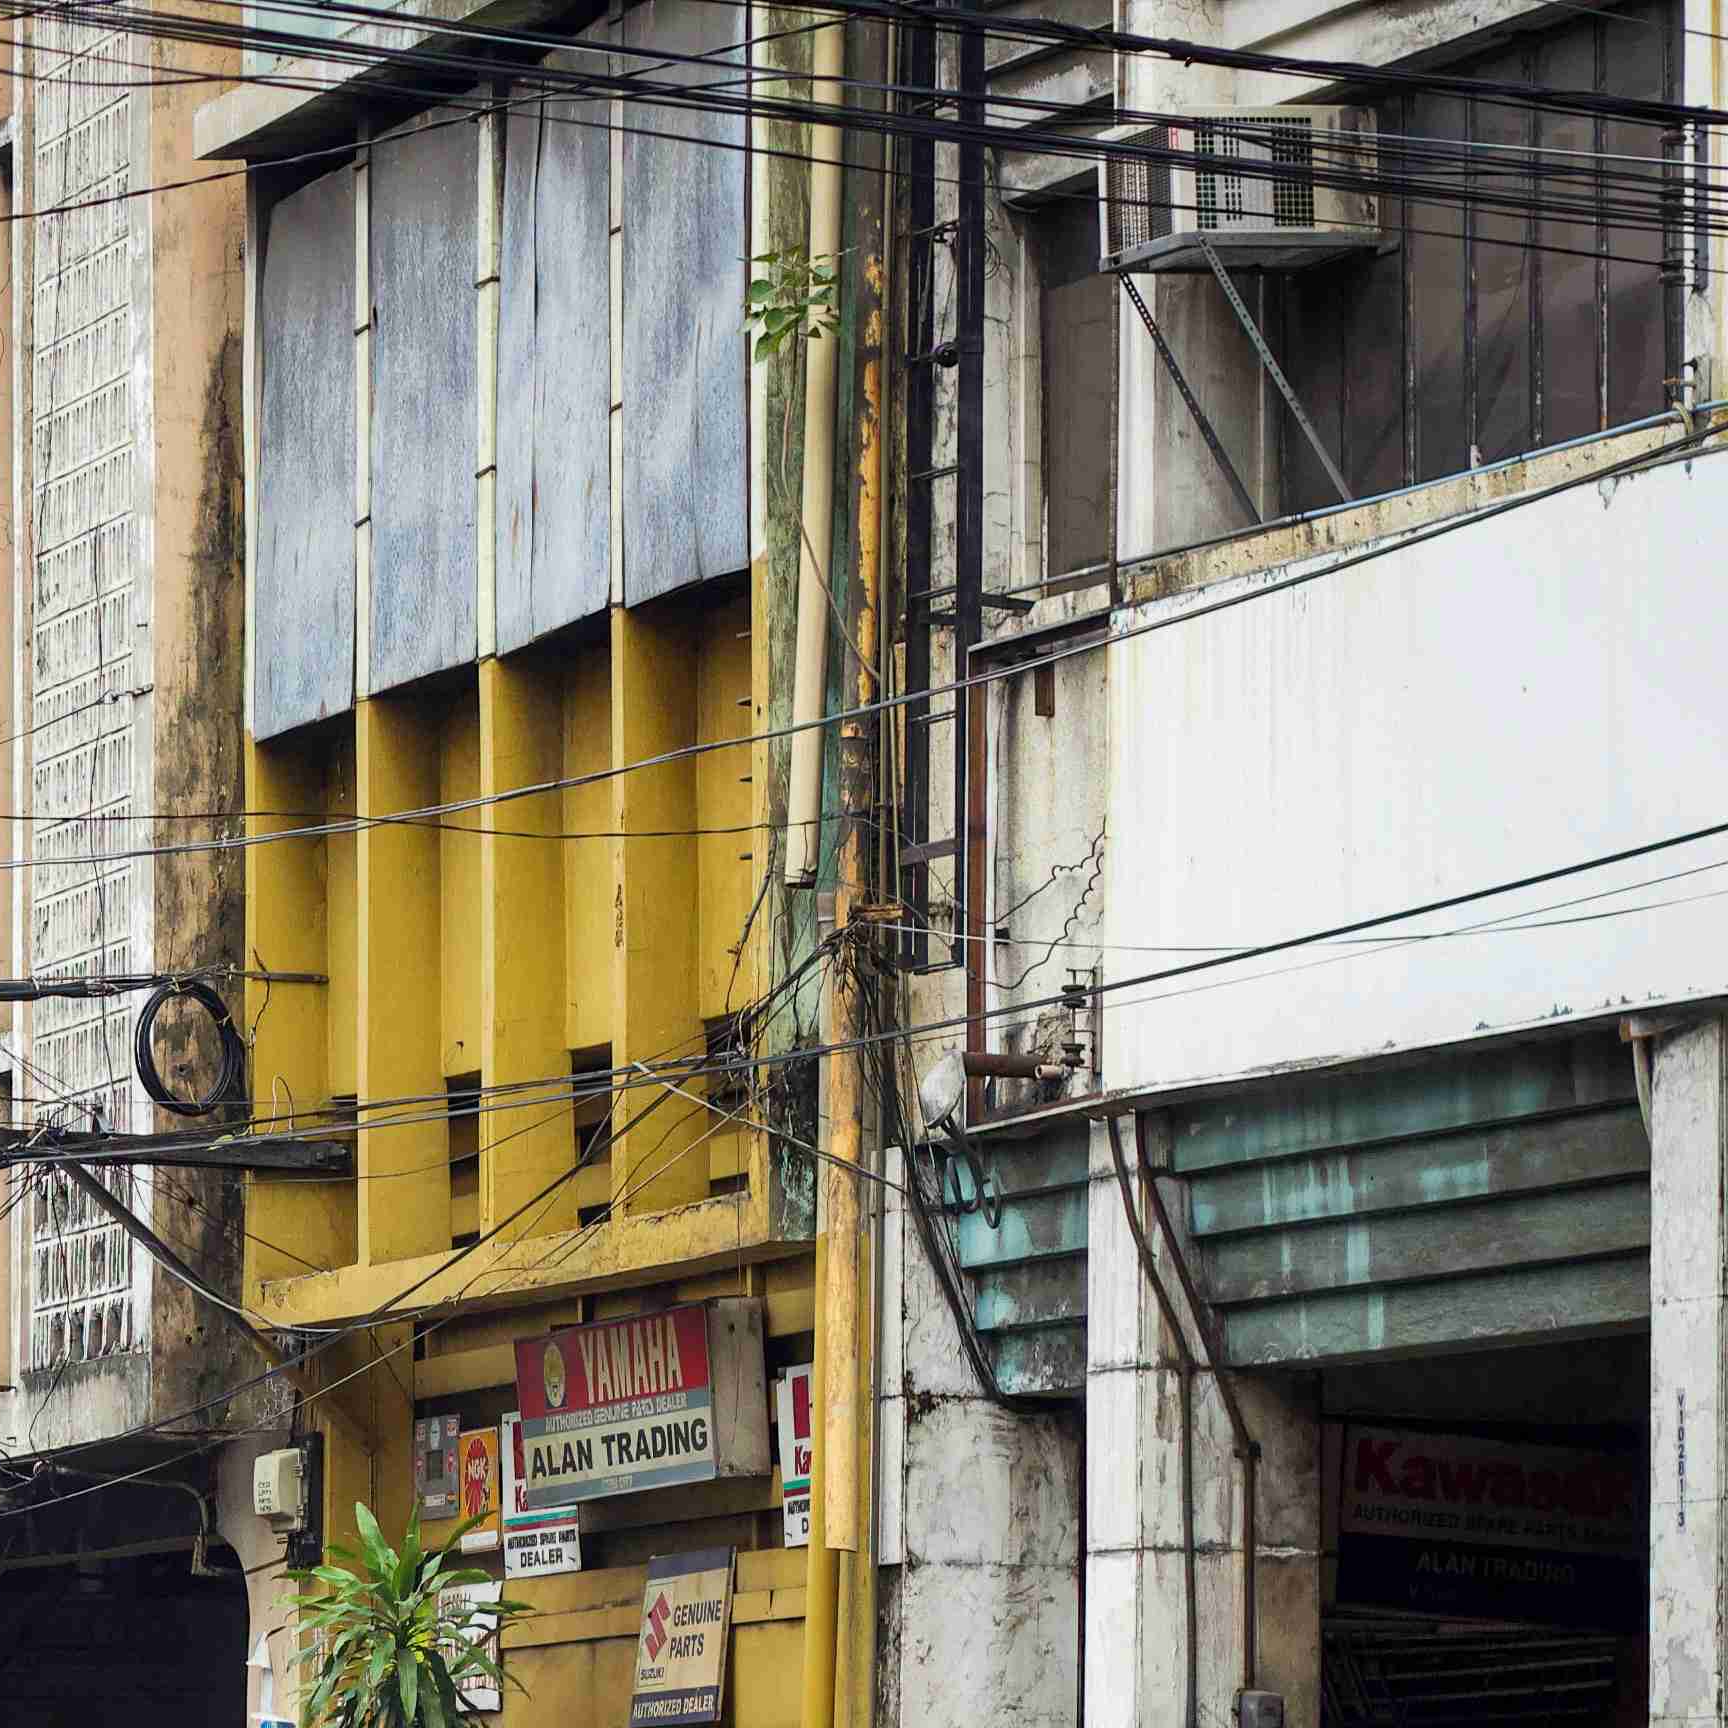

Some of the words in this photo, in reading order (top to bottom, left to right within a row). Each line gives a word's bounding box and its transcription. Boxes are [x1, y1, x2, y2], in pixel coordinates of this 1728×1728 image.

[578, 1316, 683, 1403] YAMAHA
[545, 1406, 593, 1433] AUTHORIZED
[594, 1402, 630, 1427] GENUINE
[631, 1399, 654, 1420] PARTS
[656, 1393, 687, 1416] DEALER
[532, 1430, 593, 1480] ALAN
[601, 1418, 708, 1466] TRADING
[1355, 1505, 1458, 1530] AUTHORIZED
[508, 1534, 537, 1550] AUTHORIZED
[521, 1548, 563, 1568] DEALER
[1415, 1551, 1476, 1578] ALAN
[1482, 1557, 1576, 1586] TRADING
[673, 1600, 722, 1627] GENUINE
[669, 1633, 704, 1659] PARTS
[640, 1667, 665, 1680] SUZUKI
[632, 1697, 682, 1721] AUTHORIZED
[683, 1694, 714, 1714] DEALER
